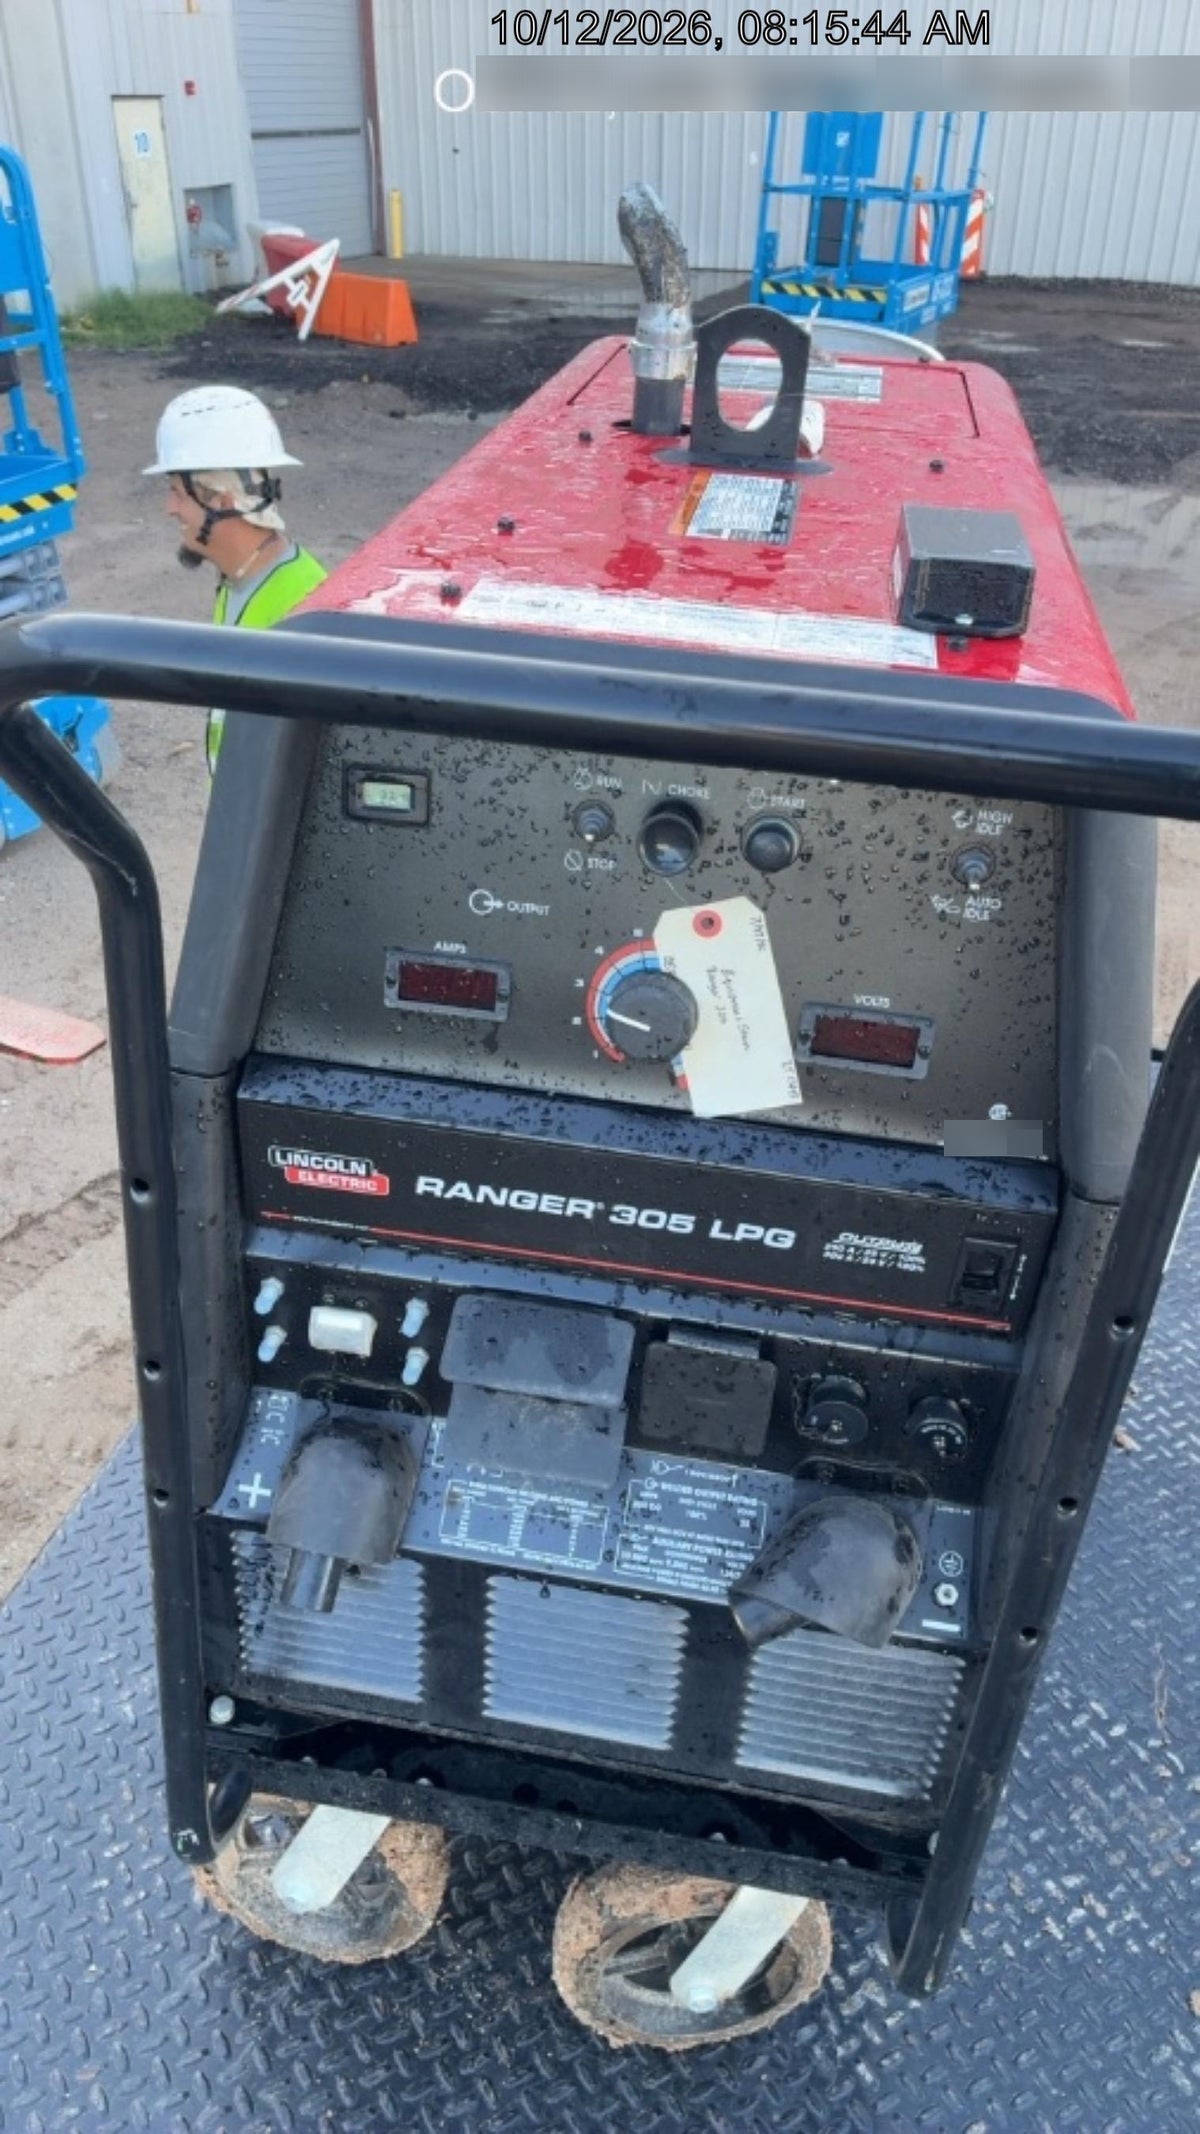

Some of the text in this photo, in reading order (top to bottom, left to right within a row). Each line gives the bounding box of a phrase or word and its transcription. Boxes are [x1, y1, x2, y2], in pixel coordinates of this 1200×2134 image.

[667, 783, 711, 801] CHOKE
[768, 795, 806, 809] START
[976, 810, 1013, 824] HIGH
[975, 821, 1005, 836] IDLE
[507, 901, 551, 916] OUTPUT
[964, 895, 1002, 910] AUTO
[962, 907, 991, 922] IDLE
[433, 940, 467, 954] AMPS
[853, 994, 890, 1009] VOLTS
[275, 1150, 367, 1175] LINCOLN
[297, 1171, 379, 1192] ELECTRIC
[608, 1203, 696, 1235] 305
[709, 1218, 798, 1250] LPG
